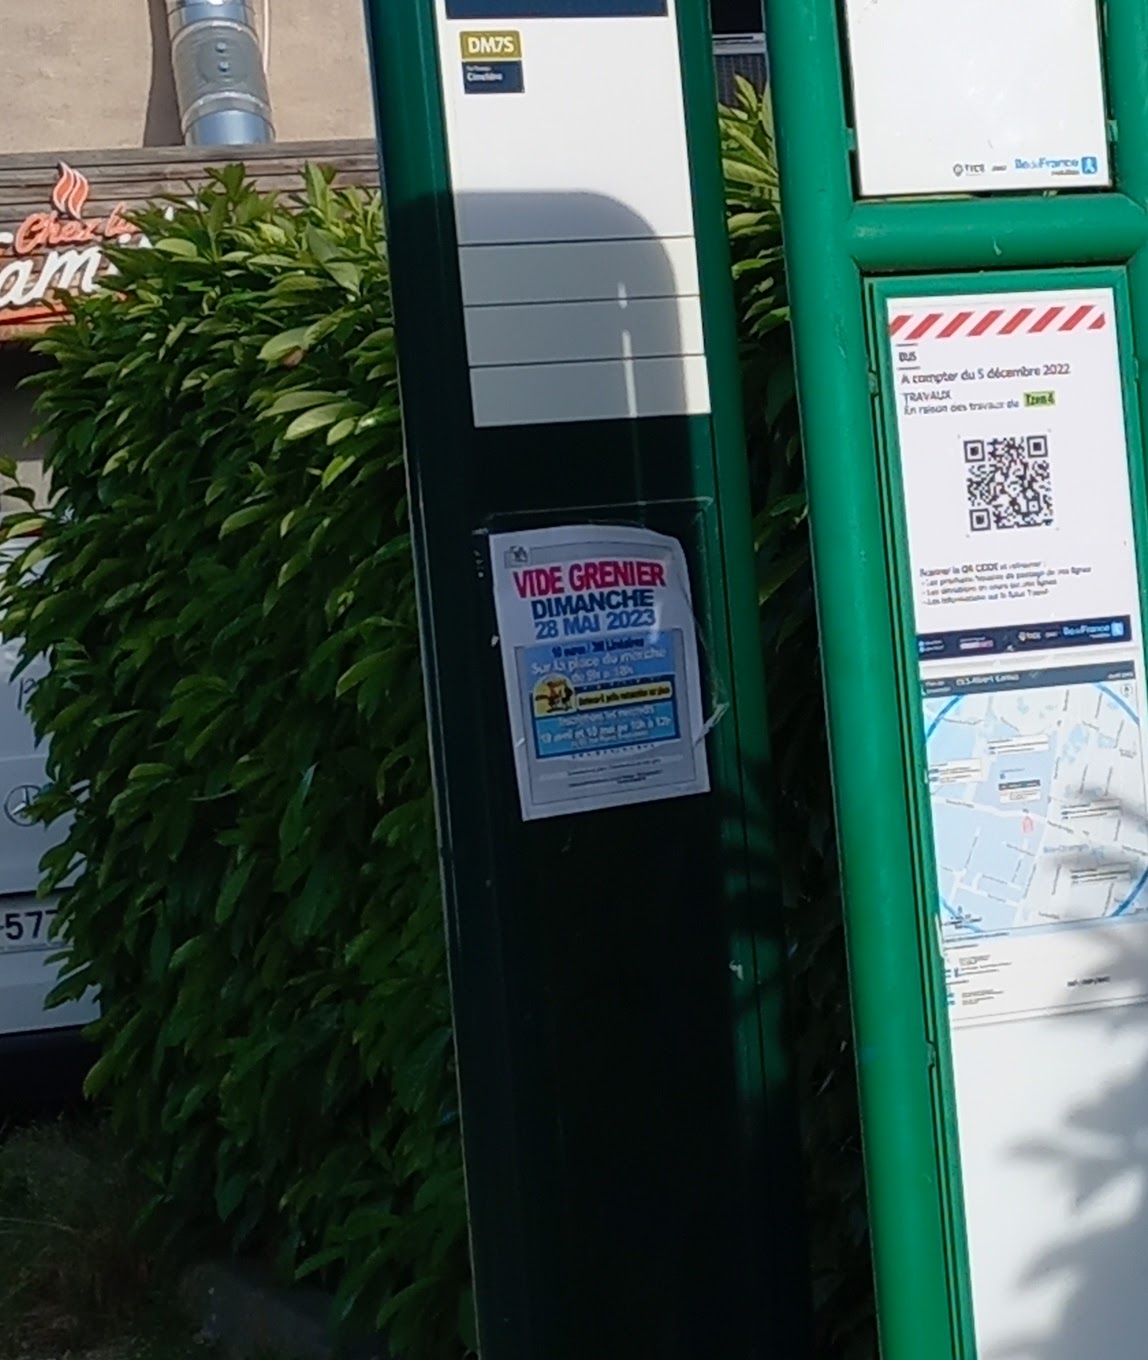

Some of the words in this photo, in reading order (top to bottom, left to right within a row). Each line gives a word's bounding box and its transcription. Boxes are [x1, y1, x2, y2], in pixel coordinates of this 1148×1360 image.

[467, 36, 515, 54] DM7S
[15, 212, 100, 254] Chez
[898, 351, 917, 362] BUS
[912, 371, 958, 385] compter
[961, 369, 976, 381] du
[987, 366, 1041, 380] décembre
[1042, 363, 1071, 376] 2022
[902, 390, 952, 403] TRAVAUX
[513, 565, 563, 598] VIDE
[569, 560, 667, 596] GRENIER
[530, 589, 655, 620] DIMANCHE
[535, 620, 558, 640] 28
[564, 614, 600, 636] MAI
[607, 609, 656, 630] 2023
